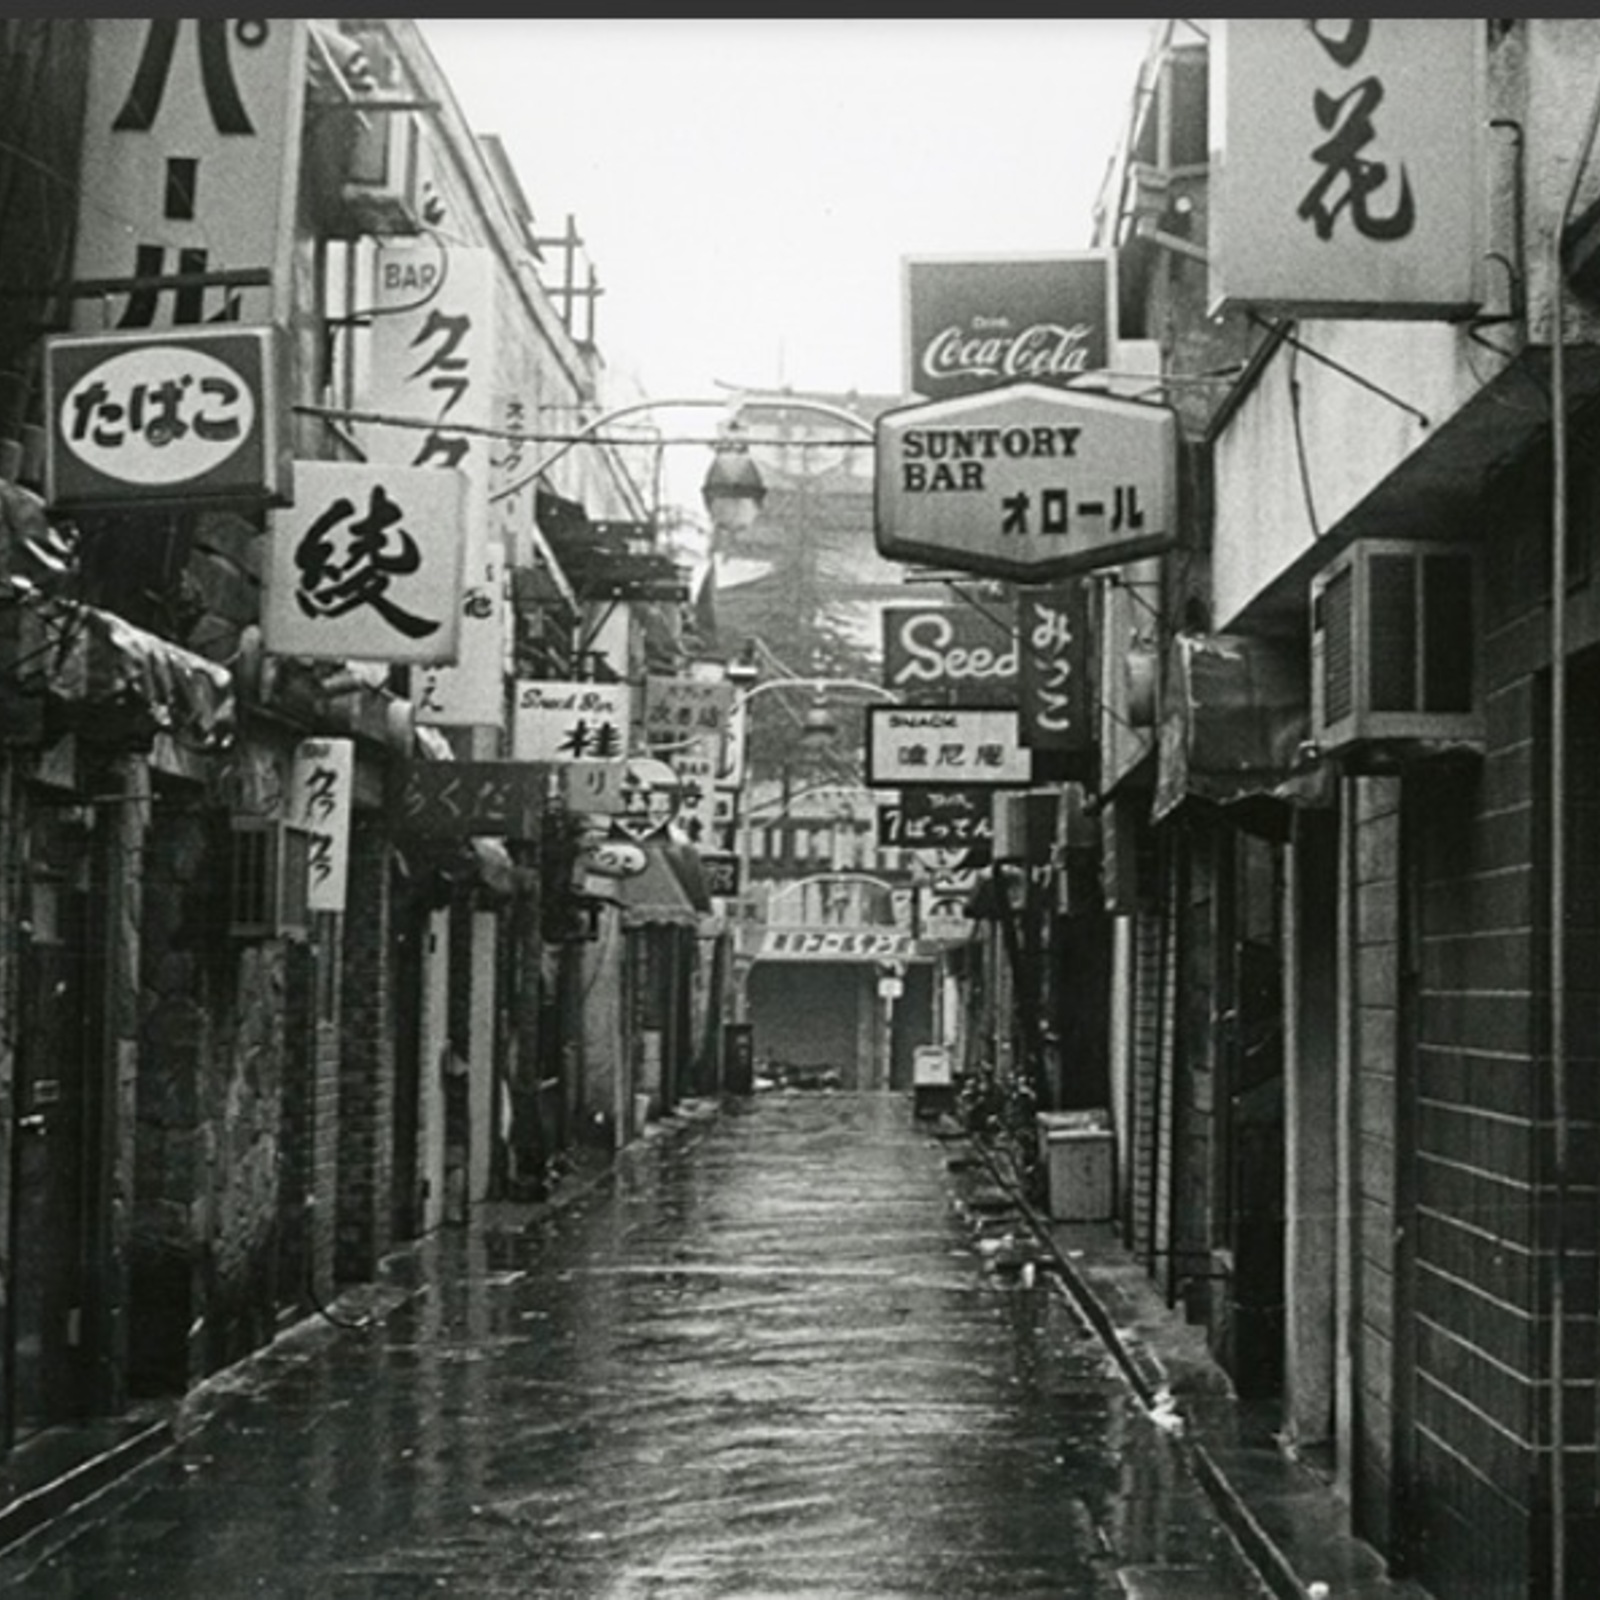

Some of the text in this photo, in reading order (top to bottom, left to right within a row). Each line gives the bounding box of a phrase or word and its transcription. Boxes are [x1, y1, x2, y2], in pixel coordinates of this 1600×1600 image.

[384, 263, 436, 290] BAR
[923, 323, 1094, 378] Coca-Cola
[72, 373, 241, 447] たばこ
[902, 427, 1082, 458] SUNTORY
[903, 461, 985, 492] BAR
[1002, 486, 1144, 535] オロール
[893, 613, 1020, 685] Seed
